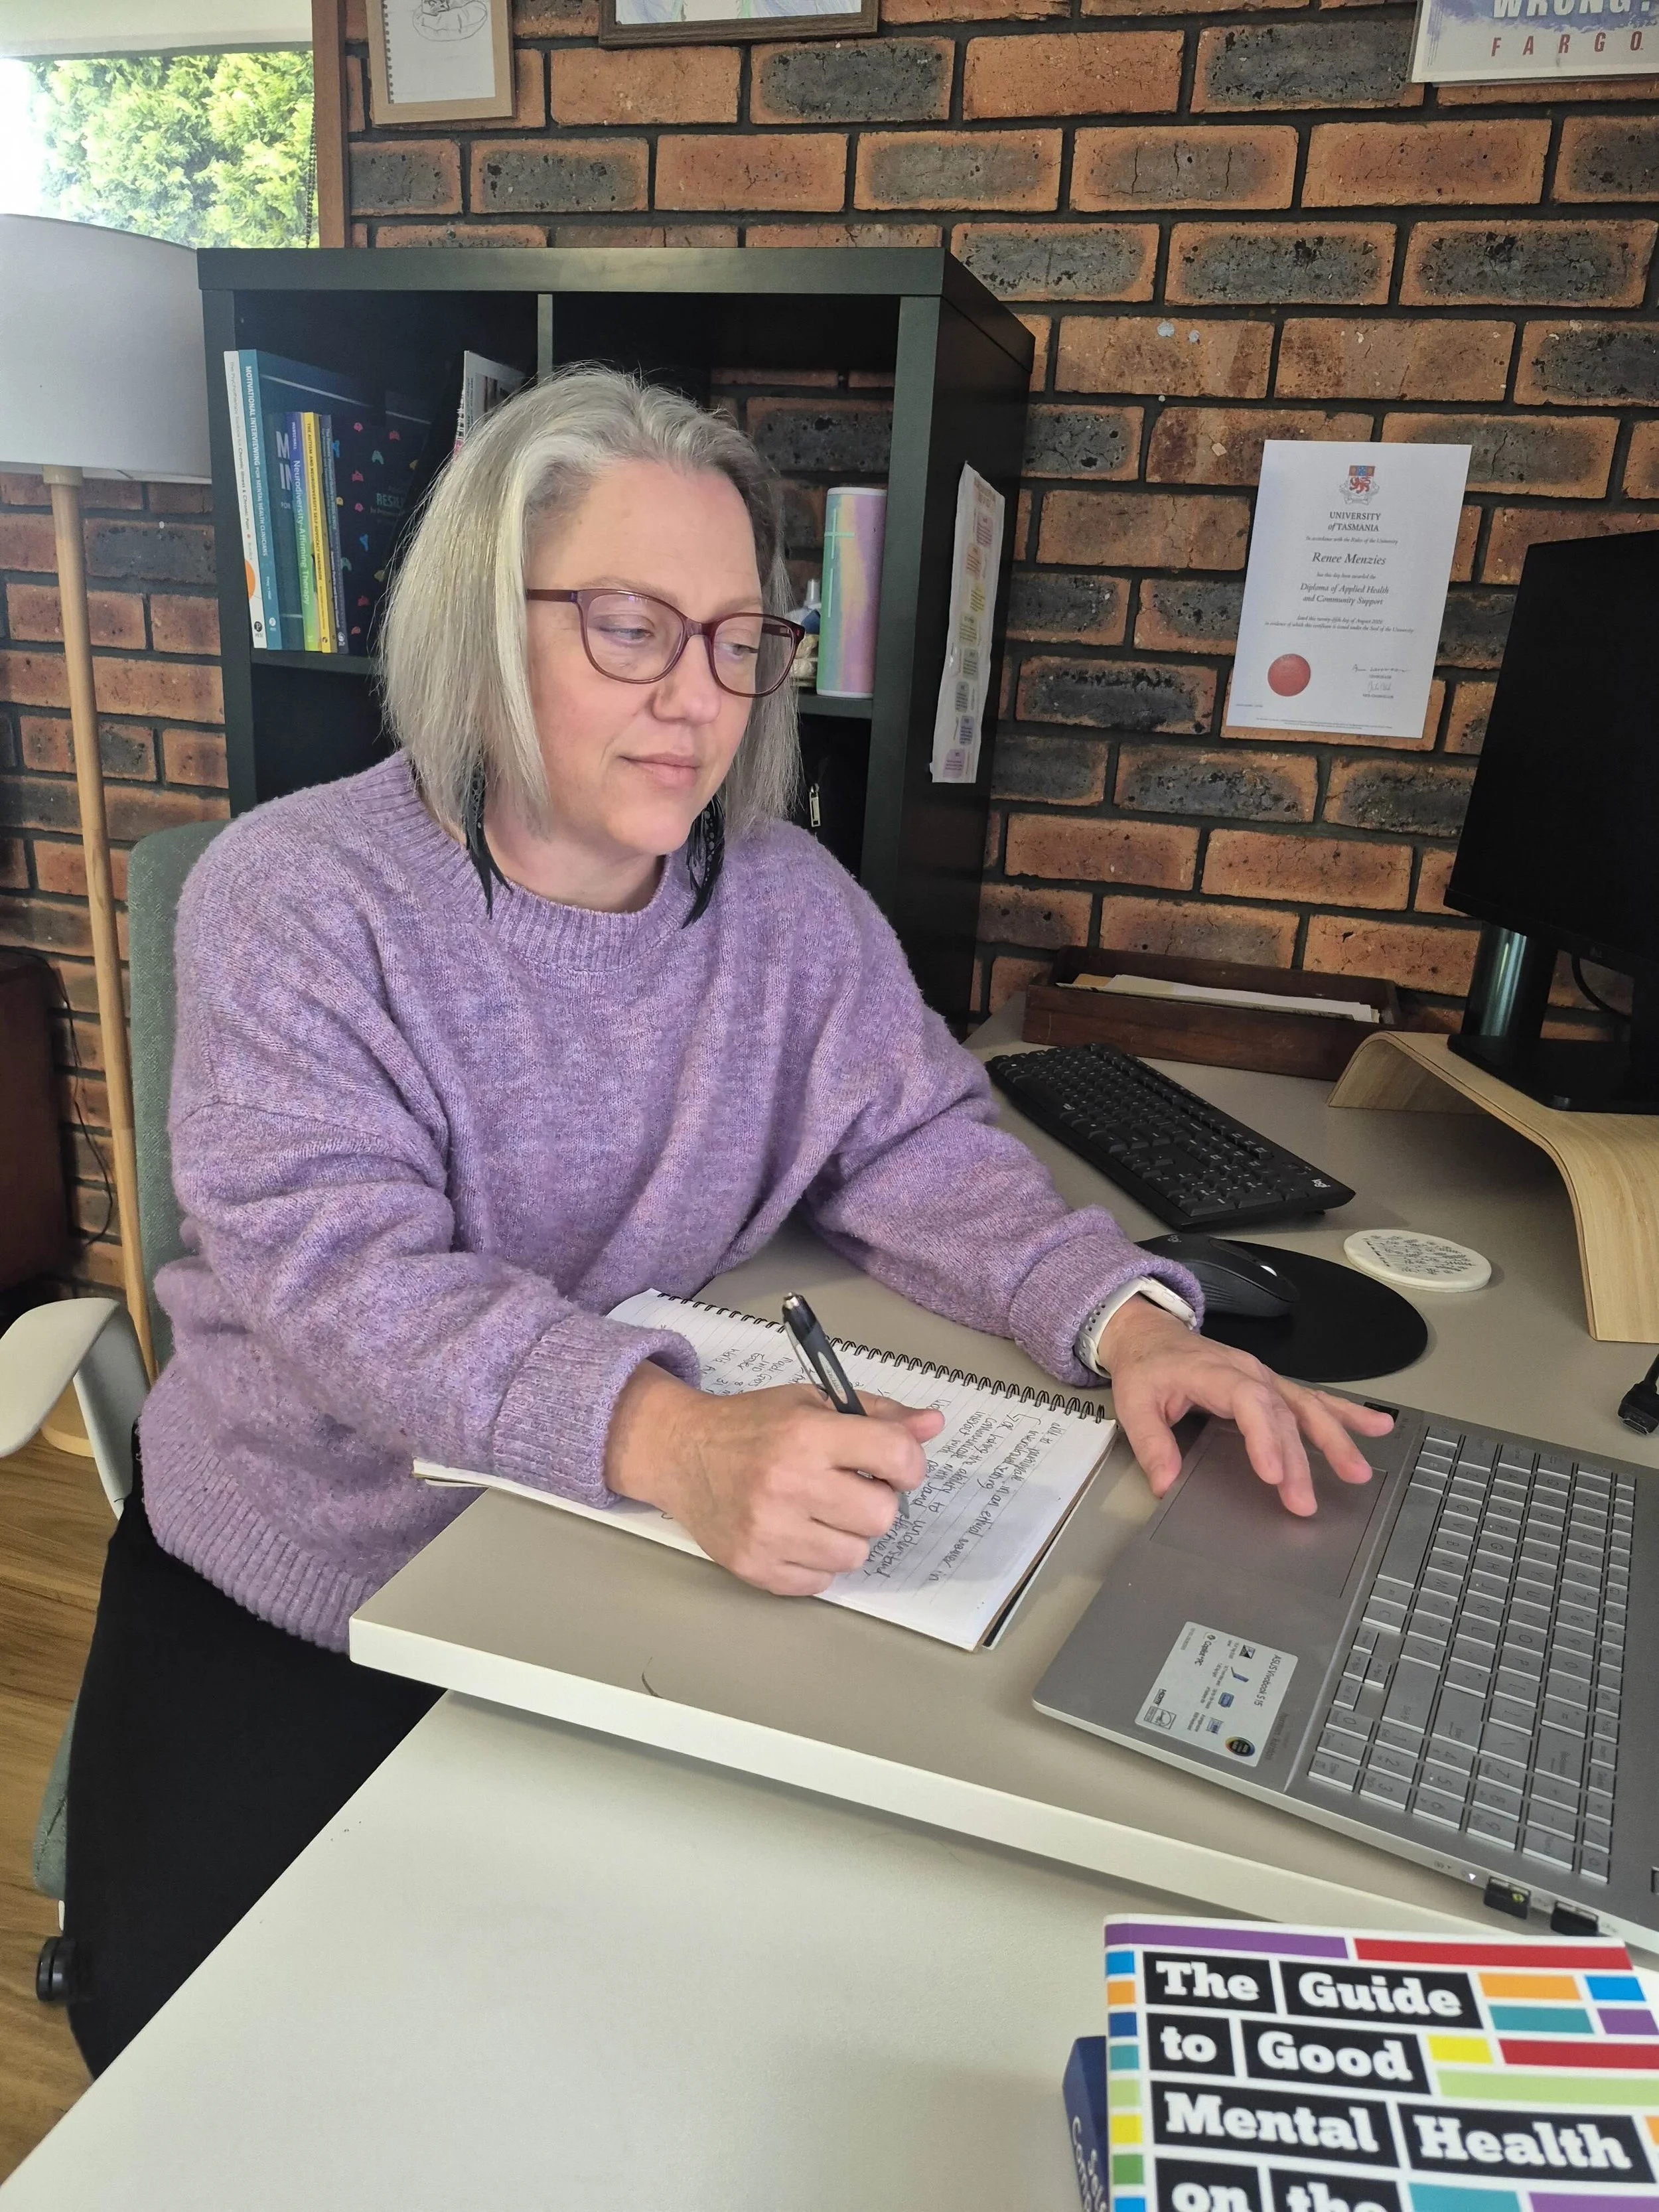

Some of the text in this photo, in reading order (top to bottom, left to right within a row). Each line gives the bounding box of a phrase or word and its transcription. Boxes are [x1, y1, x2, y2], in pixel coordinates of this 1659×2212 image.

[1491, 31, 1642, 56] FARGO
[246, 366, 255, 417] MOTIVATIONAL
[250, 417, 261, 467] INTERVIEWING
[256, 479, 265, 502] MENTAL
[257, 502, 266, 524] HEALTH
[293, 460, 307, 568] Neurodiversity-Affirming
[1329, 511, 1381, 521] UNIVERSITY
[1328, 522, 1380, 532] of TASMANIA
[259, 524, 268, 556] CLINICIANS
[1312, 552, 1387, 565] Renee Menzies
[1300, 583, 1390, 595] Diploma of Applied Health
[1316, 595, 1356, 607] Community
[1356, 597, 1384, 608] Support
[928, 1501, 946, 1513] to
[1269, 1653, 1282, 1671] ASUS
[1258, 1669, 1275, 1695] Vivobook
[1155, 1958, 1465, 2019] The Guide
[1159, 2026, 1413, 2082] to Good
[1164, 2091, 1632, 2170] Mental Health
[1171, 2179, 1388, 2212] on the
